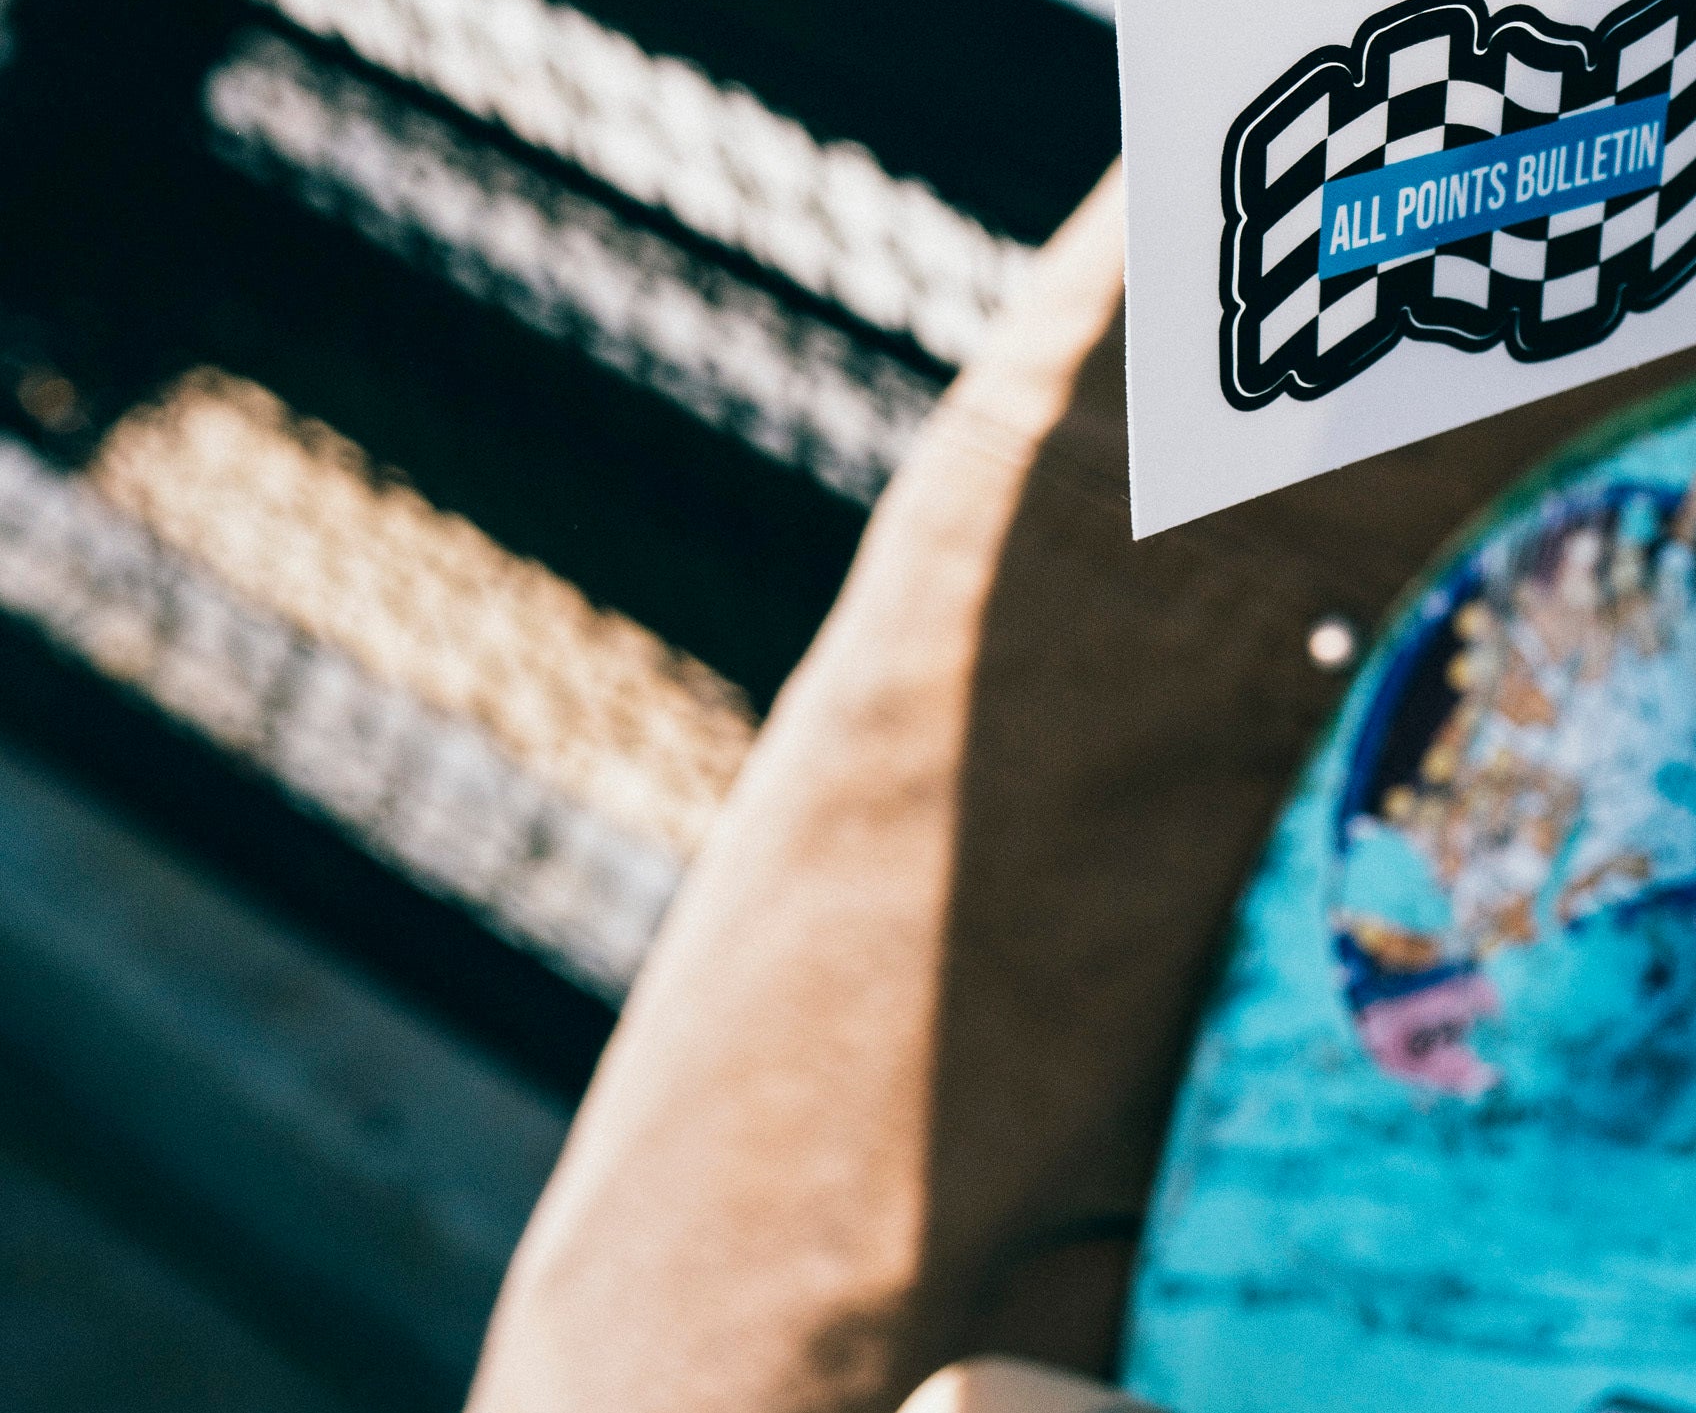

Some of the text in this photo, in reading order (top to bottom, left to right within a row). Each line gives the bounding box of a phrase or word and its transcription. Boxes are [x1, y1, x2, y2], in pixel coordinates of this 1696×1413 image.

[1329, 120, 1660, 256] ALL POINTS BULLETIN
